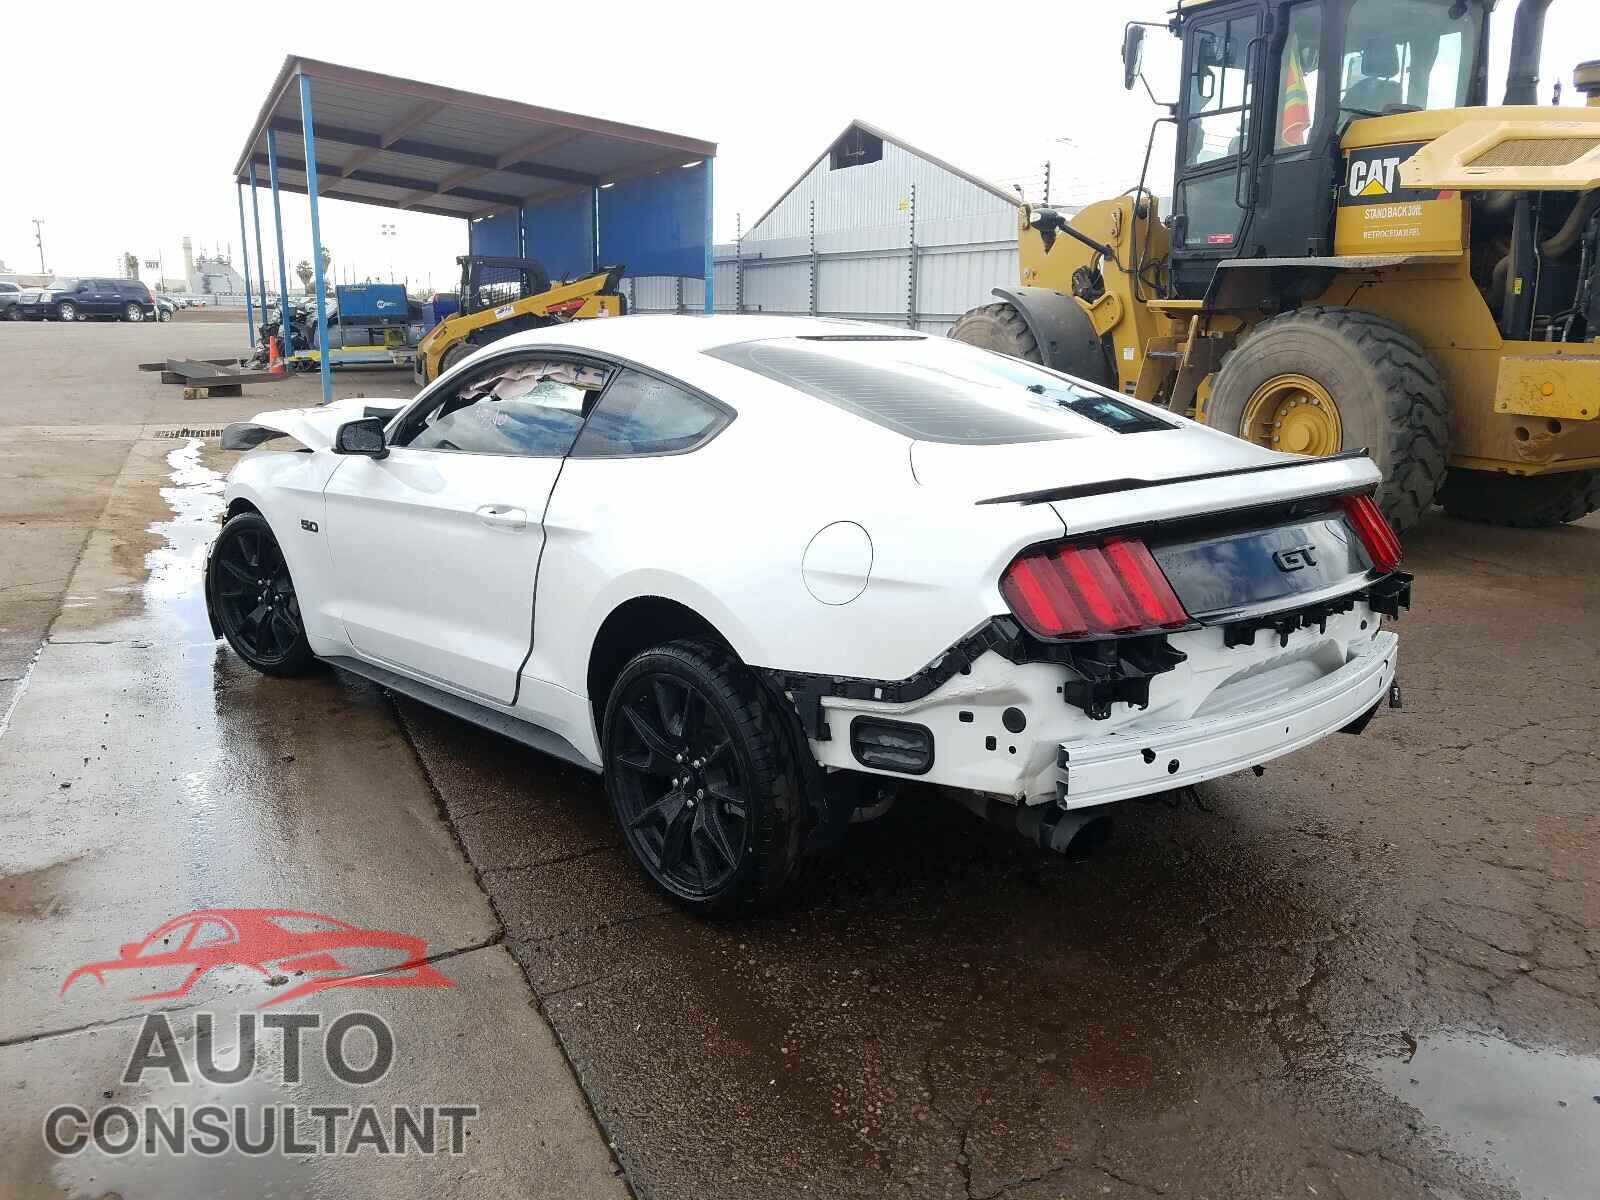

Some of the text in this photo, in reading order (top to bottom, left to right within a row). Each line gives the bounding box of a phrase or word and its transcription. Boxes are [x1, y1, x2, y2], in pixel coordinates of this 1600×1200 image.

[1349, 157, 1400, 196] CAT
[1387, 206, 1408, 218] BACK
[1272, 546, 1317, 573] GT
